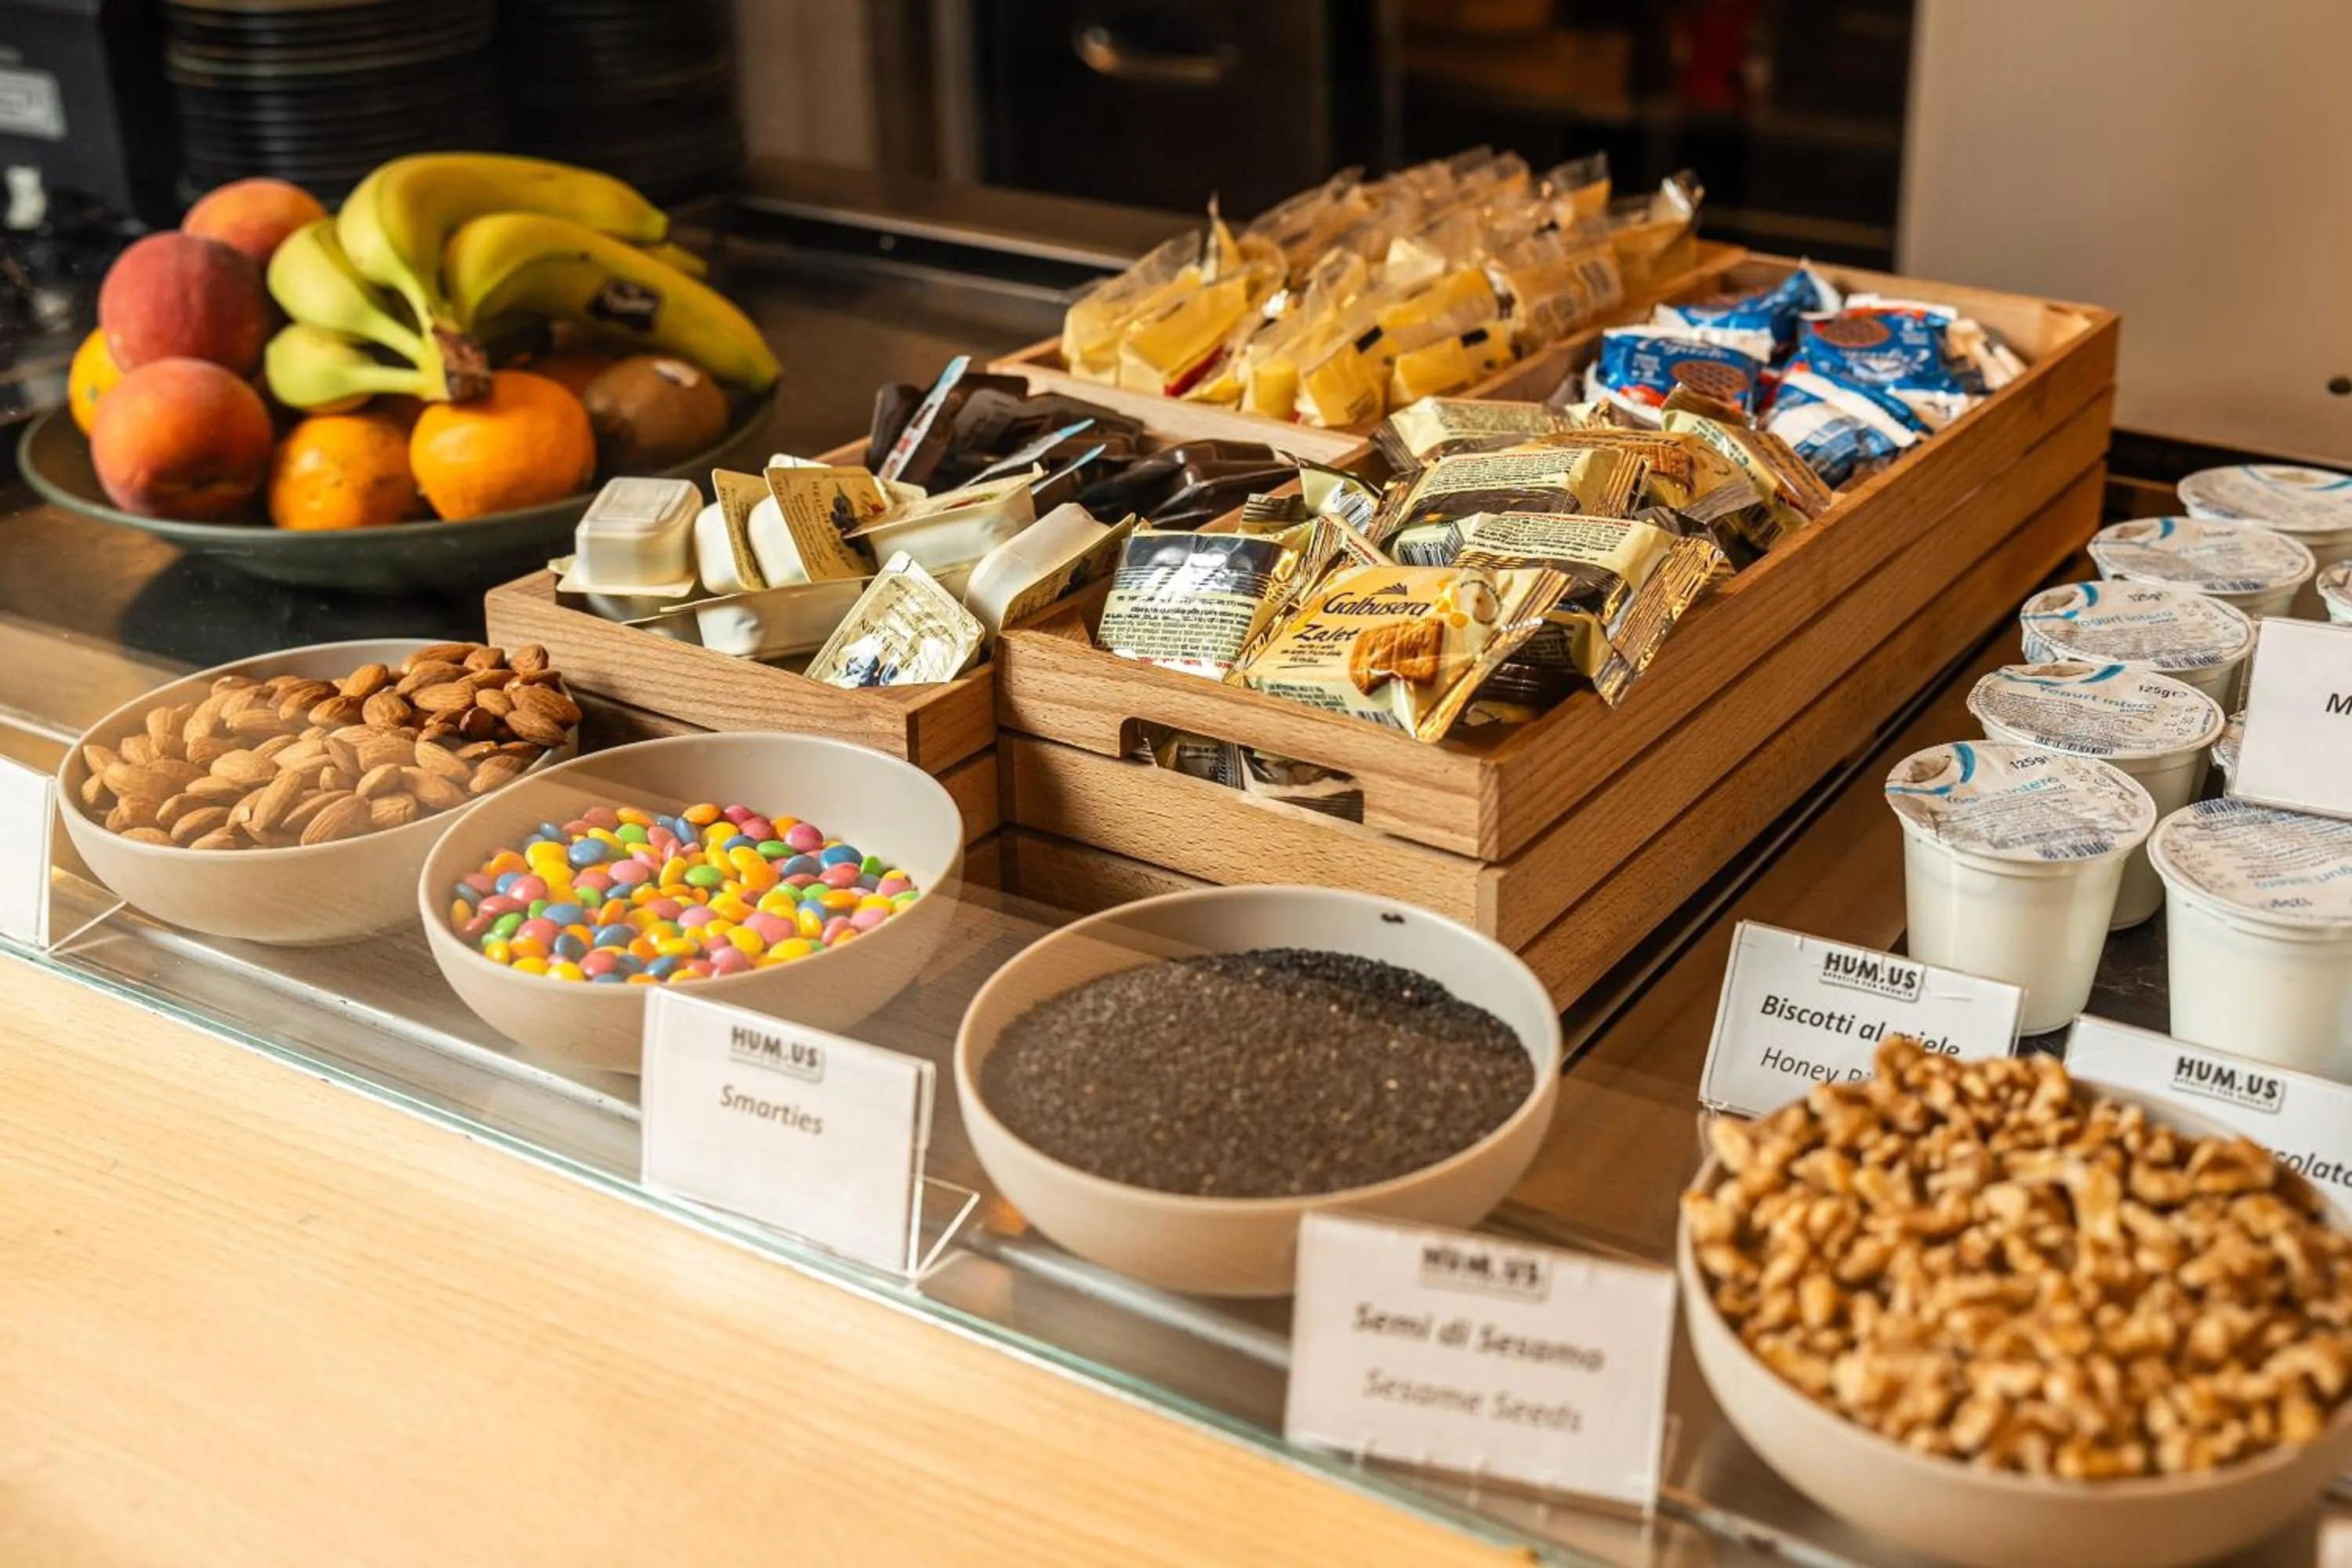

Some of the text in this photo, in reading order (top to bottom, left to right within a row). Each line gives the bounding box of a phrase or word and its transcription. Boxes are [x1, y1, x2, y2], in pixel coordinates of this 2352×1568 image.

[1323, 592, 1431, 617] Galbusera
[1824, 952, 1918, 991] HUM.US
[1761, 994, 1857, 1035] Biscotti
[1859, 1021, 1886, 1043] al
[732, 1025, 817, 1068] HUM.US
[1761, 1047, 1840, 1084] Honey
[2176, 1055, 2281, 1100] HUM.US
[720, 1083, 823, 1135] Smarties
[1353, 1302, 1606, 1371] Semi di Sesamo
[1363, 1367, 1582, 1433] Sesame Seeds
